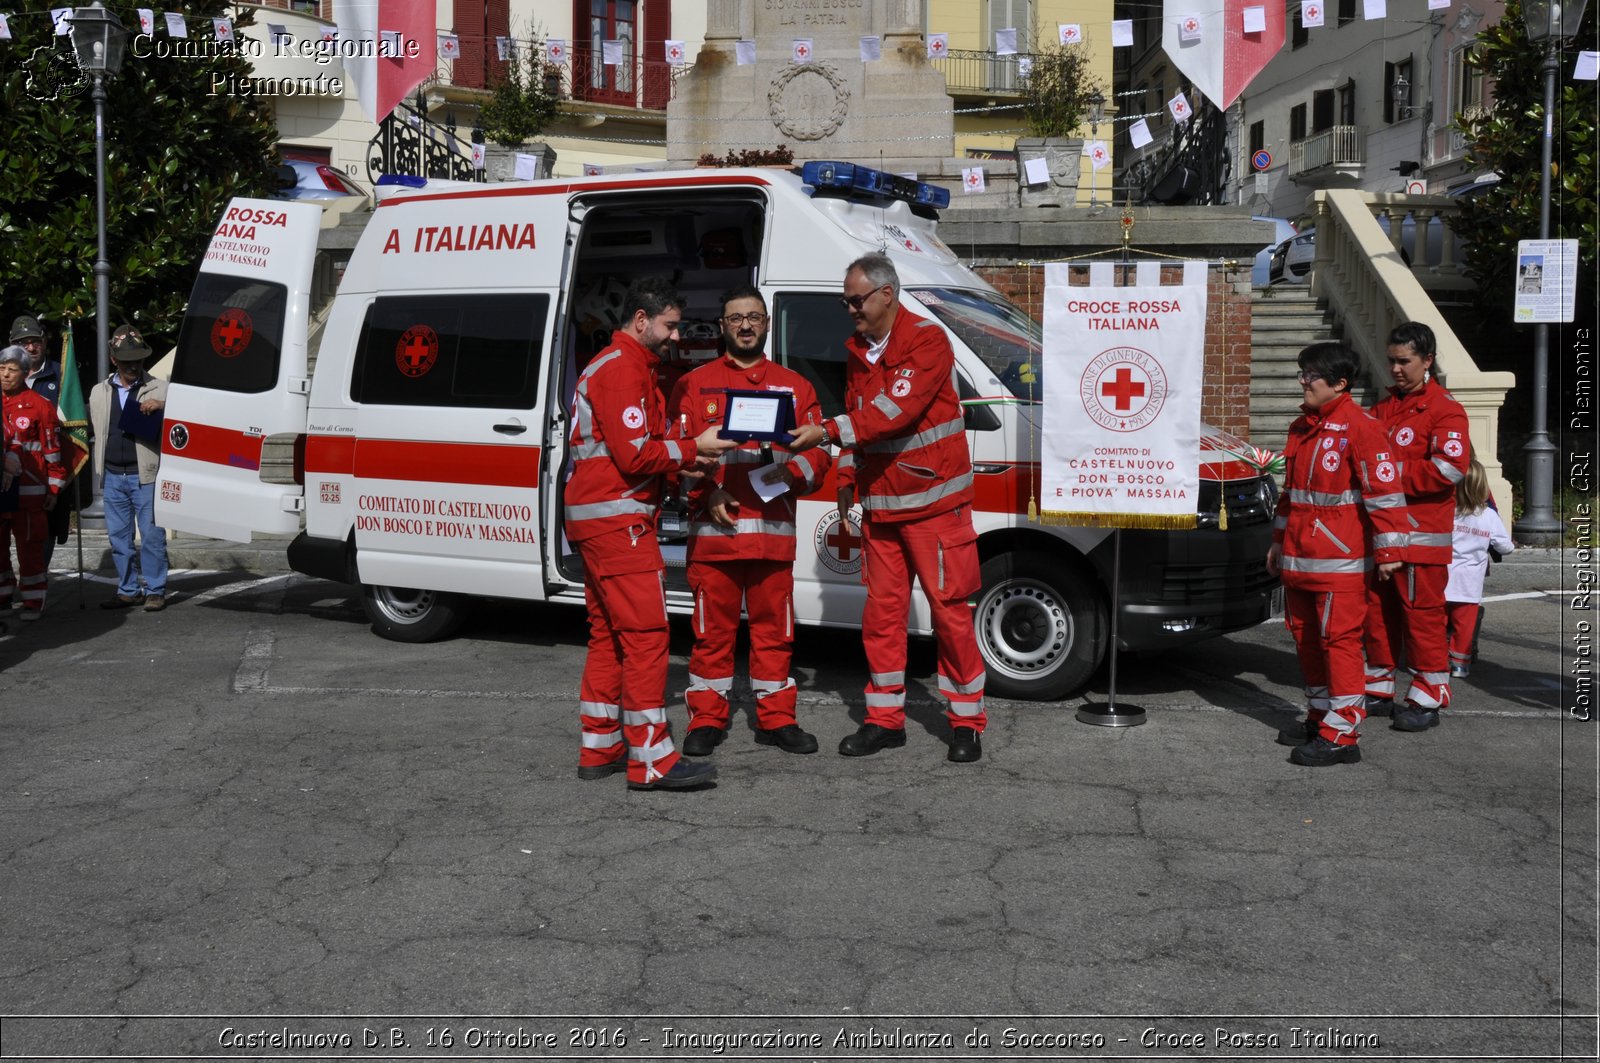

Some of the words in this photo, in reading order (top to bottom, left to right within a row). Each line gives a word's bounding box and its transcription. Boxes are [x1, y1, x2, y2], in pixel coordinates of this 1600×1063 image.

[781, 13, 796, 25] LA
[803, 13, 847, 25] PATRIA
[345, 164, 358, 176] 10
[226, 207, 288, 228] ROSSA
[382, 228, 401, 254] A
[414, 223, 536, 253] ITALIANA
[228, 253, 267, 268] MASSAIA
[1067, 300, 1121, 314] CROCE
[1128, 300, 1181, 313] ROSSA
[1088, 318, 1160, 330] ITALIANA
[1094, 356, 1107, 370] DI
[1105, 349, 1149, 369] GINEVRA
[1083, 366, 1118, 429] CONVENZIONE
[1144, 379, 1164, 417] AGOSTO
[309, 424, 327, 432] Dono
[1095, 447, 1139, 456] COMITATO
[1142, 448, 1151, 456] DI
[1069, 460, 1175, 470] CASTELNUOVO
[1079, 475, 1108, 484] DON
[1117, 475, 1165, 485] BOSCO
[162, 481, 171, 490] AT
[172, 483, 180, 492] 14
[321, 483, 330, 492] AT
[331, 484, 340, 492] 14
[161, 491, 180, 502] 12-25
[321, 493, 340, 503] 12-25
[1056, 489, 1063, 497] E
[1072, 488, 1119, 498] PIOVA'
[1127, 489, 1186, 499] MASSAIA
[359, 494, 421, 514] COMITATO
[423, 499, 436, 515] DI
[438, 500, 532, 522] CASTELNUOVO
[357, 515, 381, 531] DON
[383, 517, 423, 535] BOSCO
[425, 522, 433, 536] E
[436, 522, 476, 539] PIOVA'
[479, 524, 536, 544] MASSAIA
